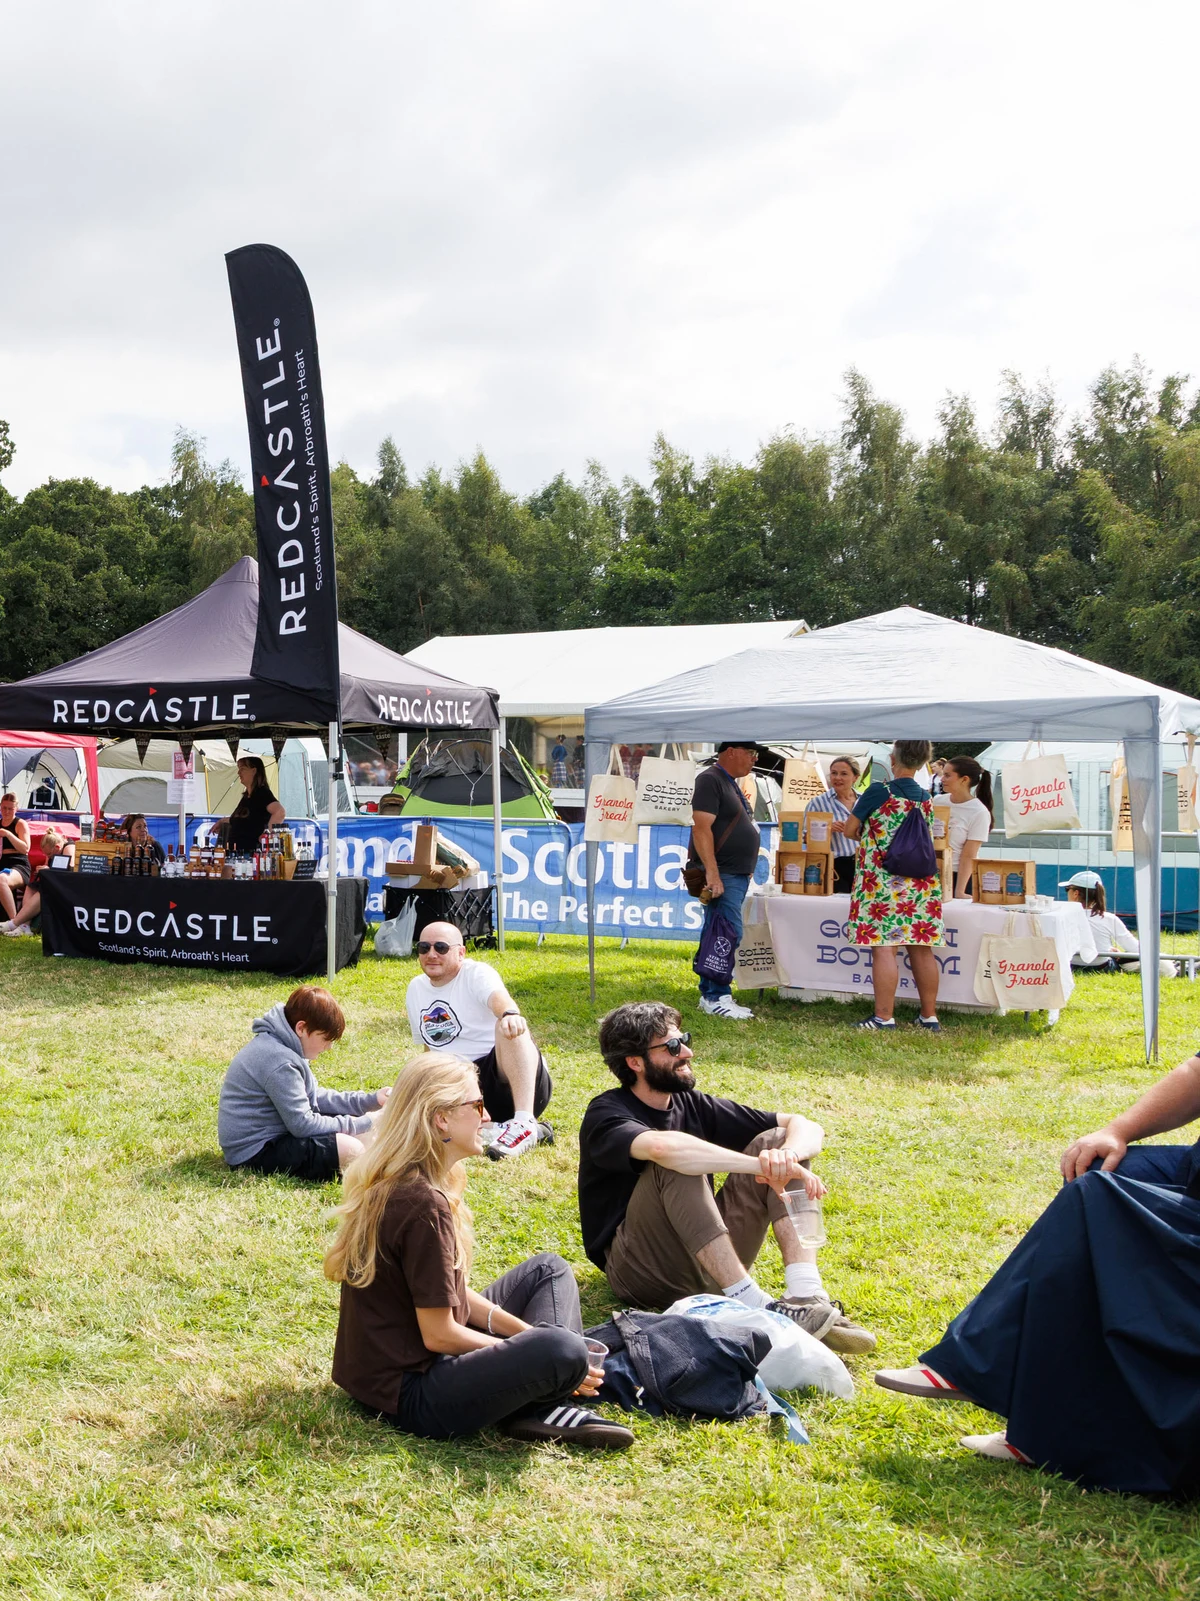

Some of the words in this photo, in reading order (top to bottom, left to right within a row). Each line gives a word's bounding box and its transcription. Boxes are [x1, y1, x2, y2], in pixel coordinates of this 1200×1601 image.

[294, 349, 307, 391] Heart
[299, 393, 316, 466] Arbroath's
[256, 327, 307, 635] REDCASTLE
[307, 469, 321, 513] Spirit,
[310, 514, 323, 591] Scotland's
[53, 693, 252, 723] REDCASTLE
[377, 694, 474, 725] REDCASTLE
[645, 784, 693, 796] GOLDEN
[790, 778, 825, 788] GOLDE
[1009, 777, 1067, 801] Granola
[593, 794, 634, 810] Granola
[1018, 793, 1065, 816] Freak
[598, 807, 628, 822] Freak
[502, 890, 548, 921] The
[558, 894, 674, 929] Perfect
[73, 906, 272, 943] REDCASTLE
[98, 942, 141, 956] Scotland's
[143, 946, 169, 959] Spirit,
[171, 949, 220, 962] Arbroath's
[221, 952, 250, 963] Heart
[738, 947, 774, 957] GOLDE
[997, 958, 1056, 975] Granola
[1005, 973, 1050, 989] Freak
